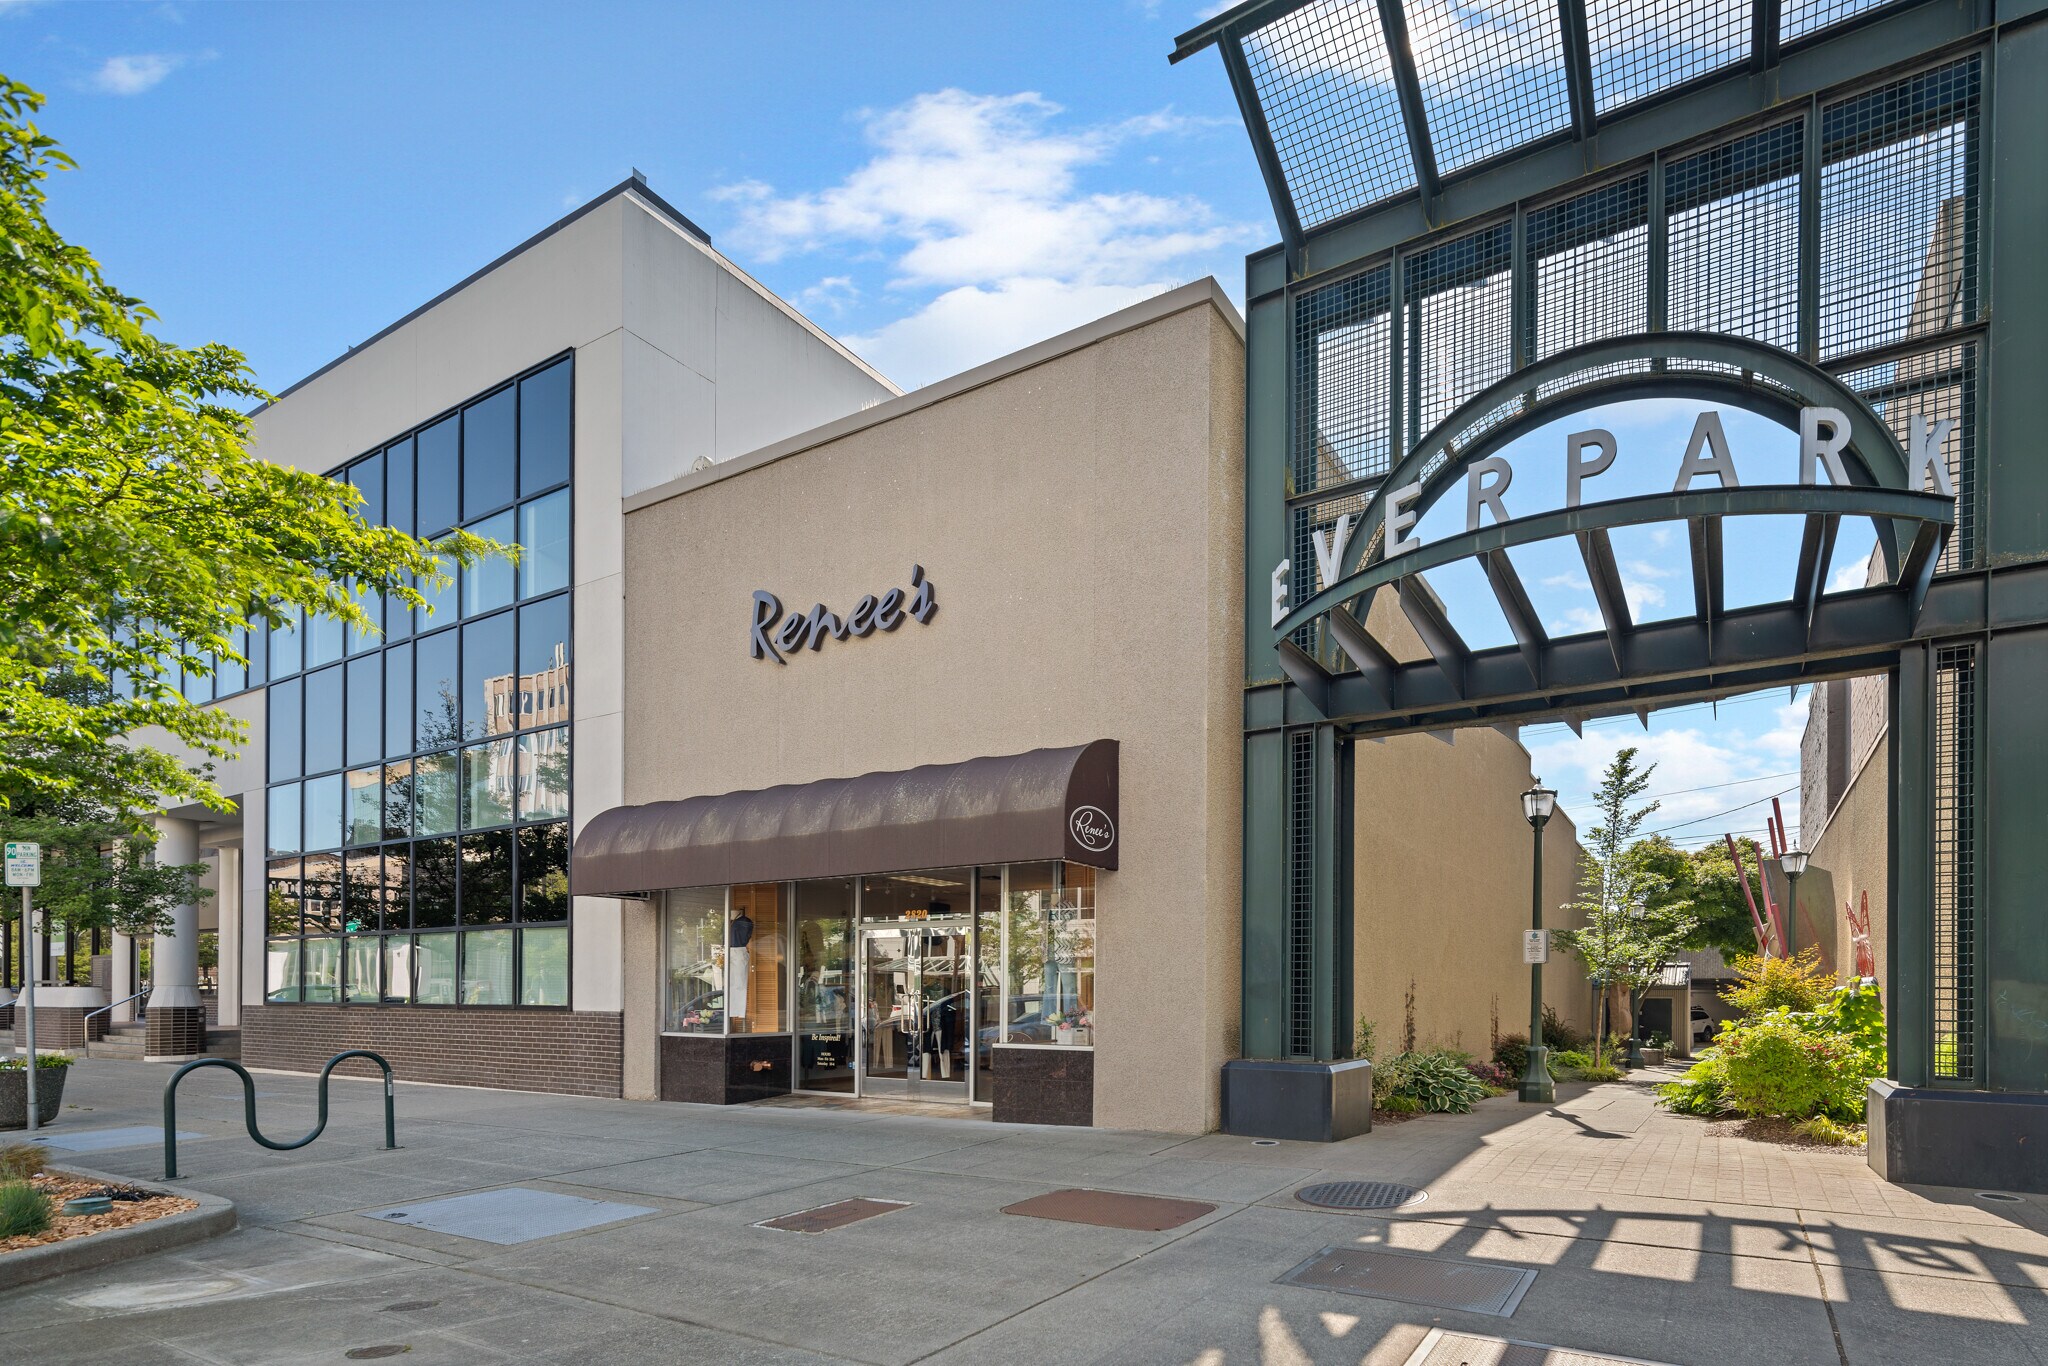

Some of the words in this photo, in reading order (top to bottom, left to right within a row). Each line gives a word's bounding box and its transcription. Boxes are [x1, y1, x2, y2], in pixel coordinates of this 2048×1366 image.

[1271, 407, 1957, 629] EVERPARK
[751, 564, 939, 665] Renee's
[1076, 811, 1109, 844] Renee's
[6, 847, 16, 856] 90
[905, 909, 928, 919] 2820
[811, 1033, 818, 1041] Be
